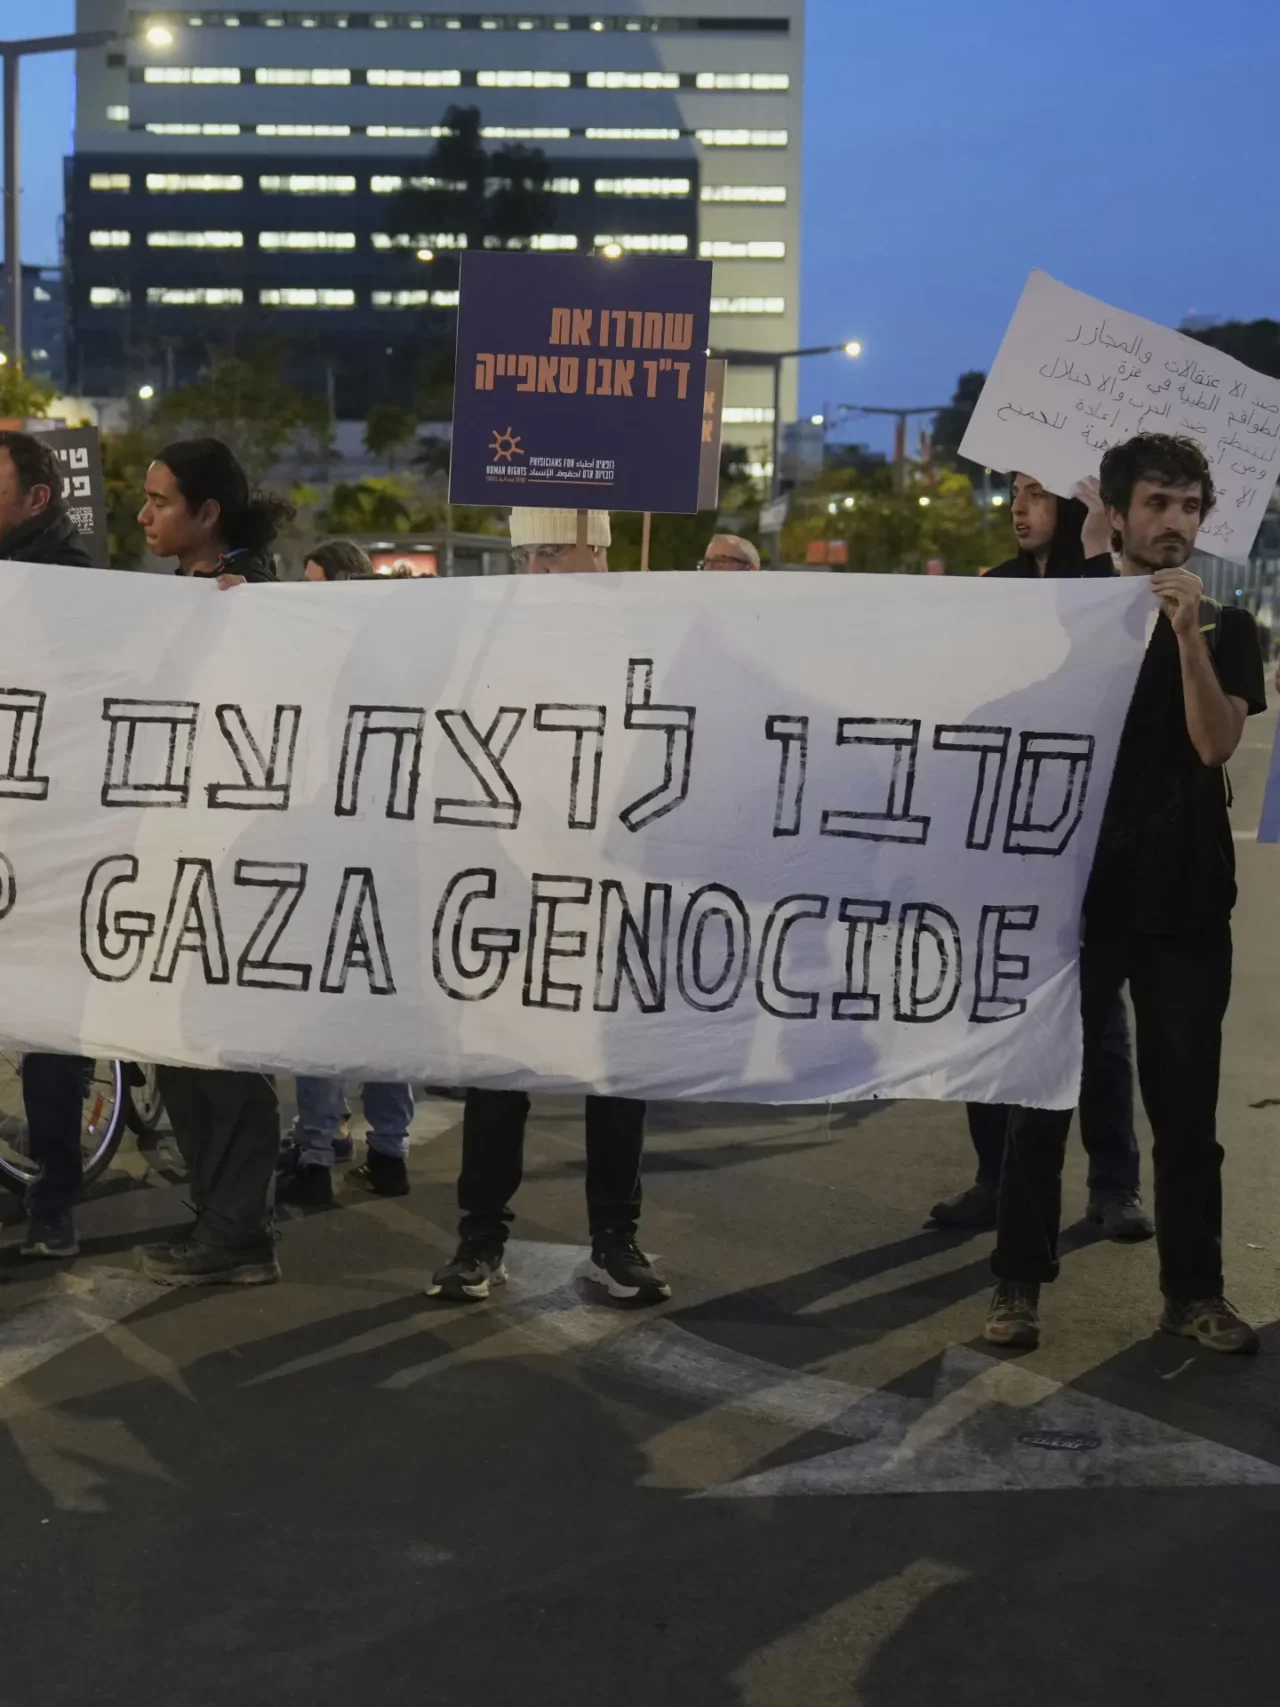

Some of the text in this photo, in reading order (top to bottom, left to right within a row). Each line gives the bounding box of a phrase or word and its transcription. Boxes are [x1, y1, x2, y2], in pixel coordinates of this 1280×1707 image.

[549, 307, 694, 350] שחררו את
[474, 353, 579, 394] סאפייה
[586, 357, 635, 397] אבו
[1118, 361, 1142, 381] غزة
[1147, 378, 1171, 395] في
[100, 697, 302, 811] עם
[332, 658, 696, 832] לרצח
[765, 714, 1096, 855] סרבו
[79, 853, 397, 996] GAZA
[431, 867, 1040, 1024] GENOCIDE
